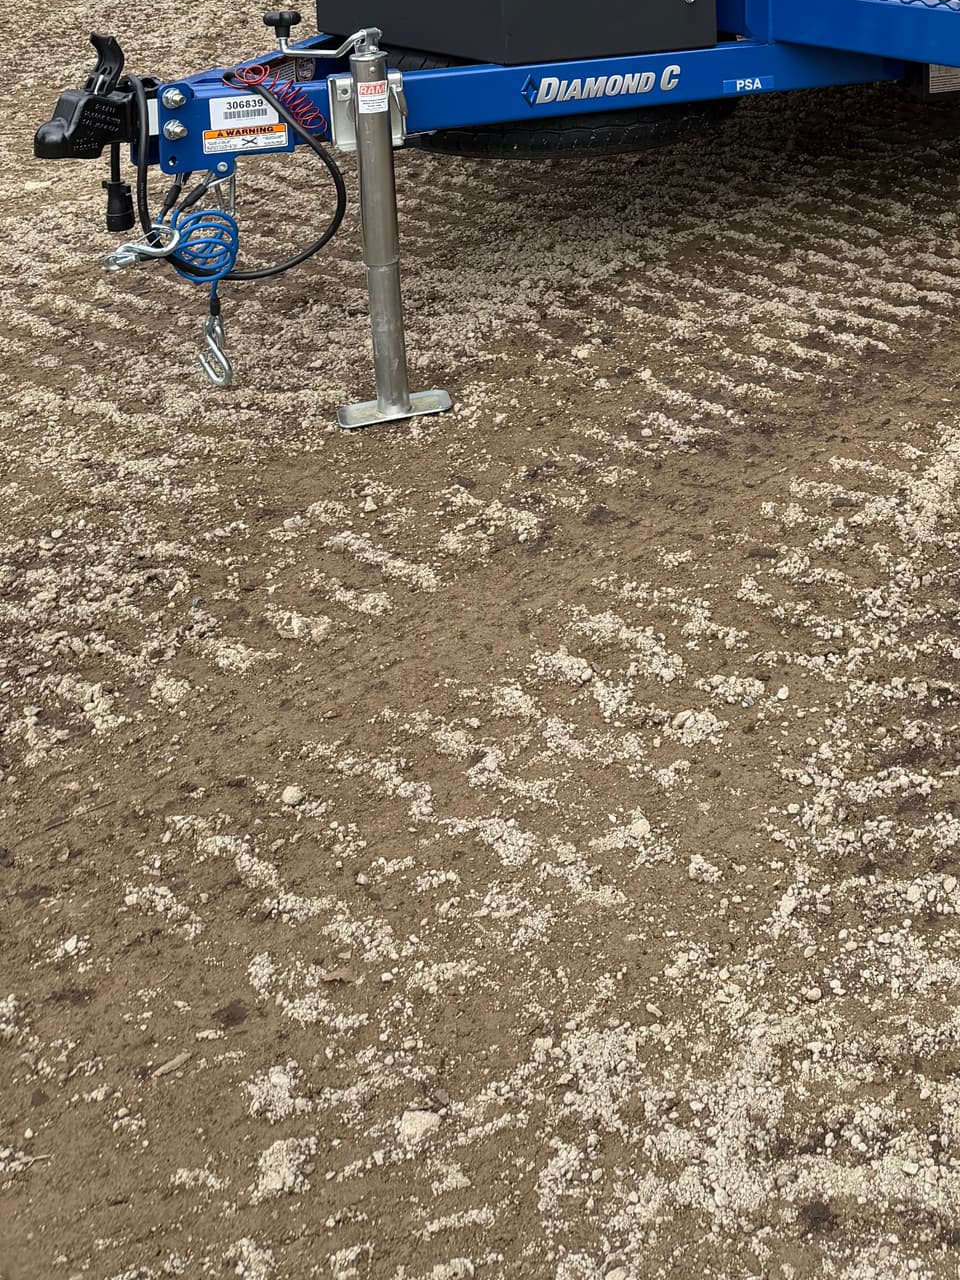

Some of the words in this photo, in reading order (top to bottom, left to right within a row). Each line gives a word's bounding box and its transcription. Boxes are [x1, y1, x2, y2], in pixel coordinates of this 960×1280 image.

[360, 84, 385, 95] RAM
[535, 71, 656, 104] DIAMOND
[660, 64, 681, 91] C
[736, 78, 762, 91] PSA
[226, 126, 274, 137] WARNING
